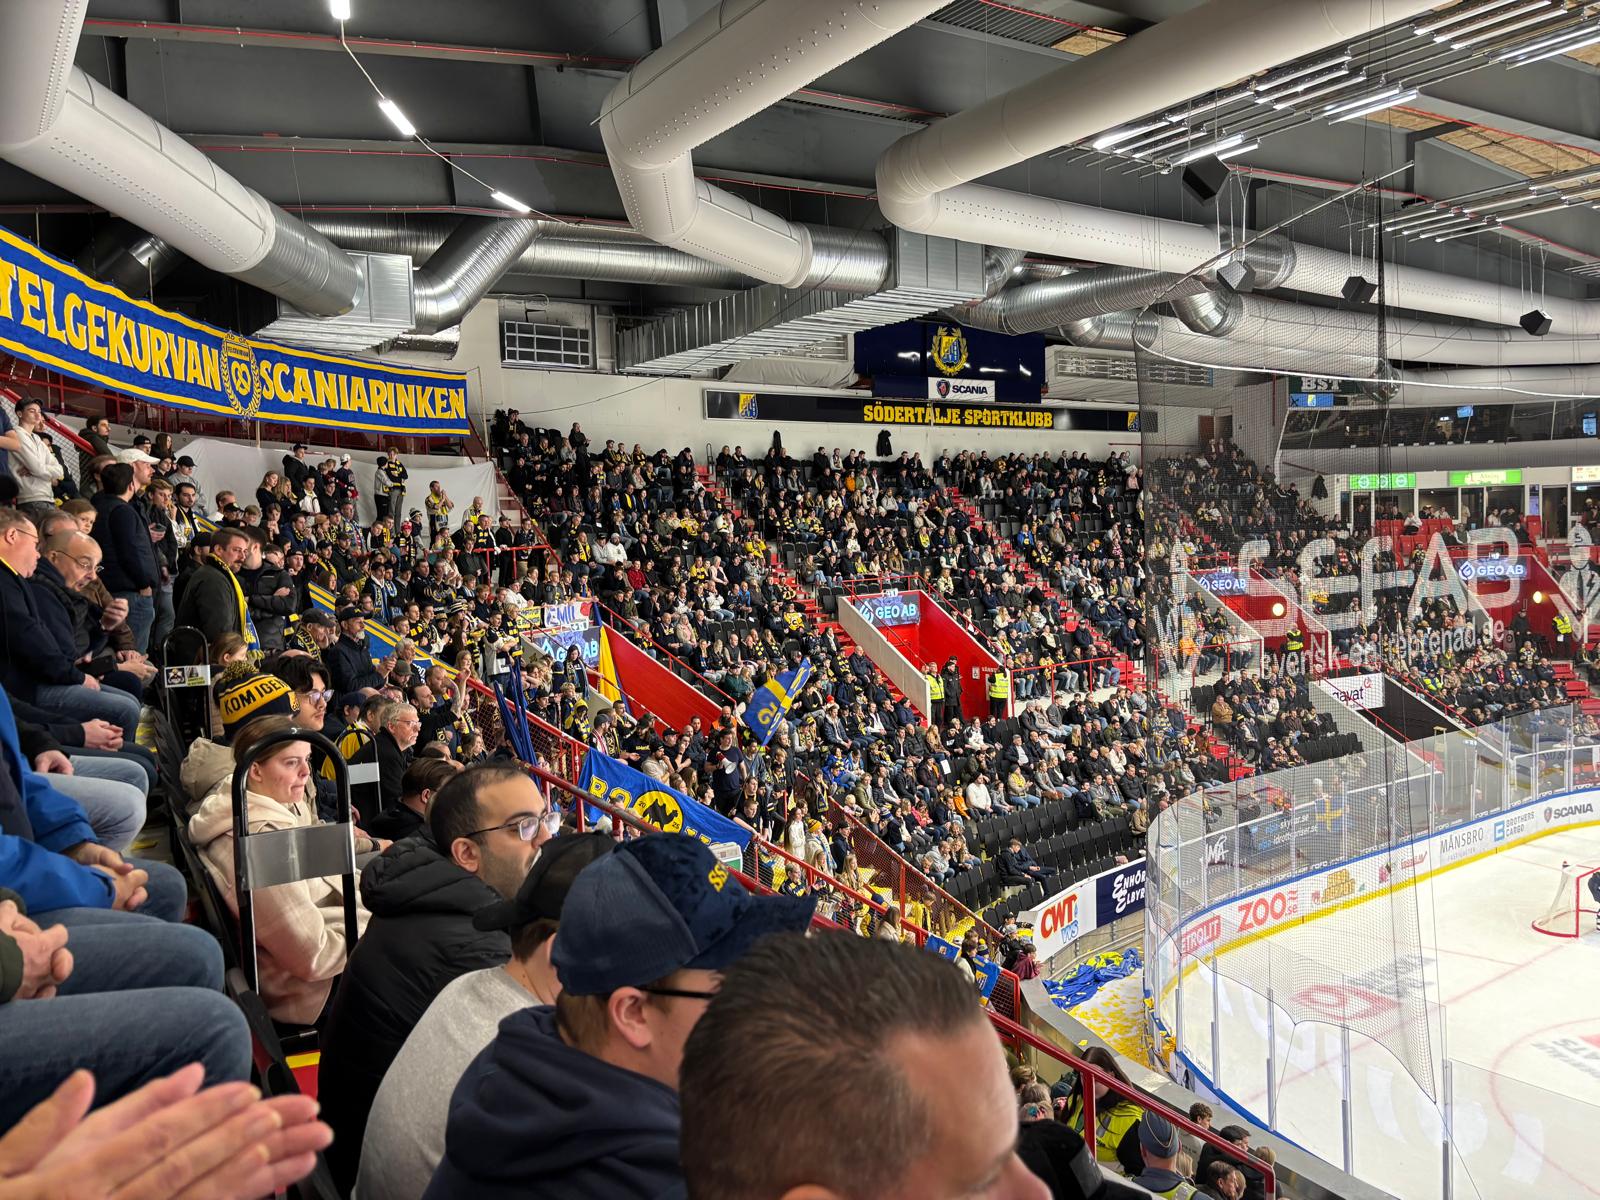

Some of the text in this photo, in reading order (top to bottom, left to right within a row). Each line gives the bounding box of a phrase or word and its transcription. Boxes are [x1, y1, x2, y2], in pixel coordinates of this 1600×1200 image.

[260, 360, 467, 420] SCANIARINKEN
[951, 384, 989, 395] SCANIA
[1301, 376, 1342, 391] BST
[863, 401, 1054, 428] SÖDERTÄLJE SPORTKLUBB
[1476, 562, 1525, 577] GEO AB
[1211, 579, 1233, 592] GEO
[875, 602, 917, 620] GEO AB
[582, 639, 599, 660] AB
[223, 688, 257, 716] KOM
[1506, 811, 1535, 828] BROTHERS
[1553, 803, 1594, 820] SCANIA
[1440, 827, 1484, 854] MÅNSBRO
[1505, 824, 1525, 838] CARGO
[1040, 893, 1078, 939] CWT
[1238, 892, 1287, 932] ZOO
[1181, 918, 1218, 953] ETROLIT
